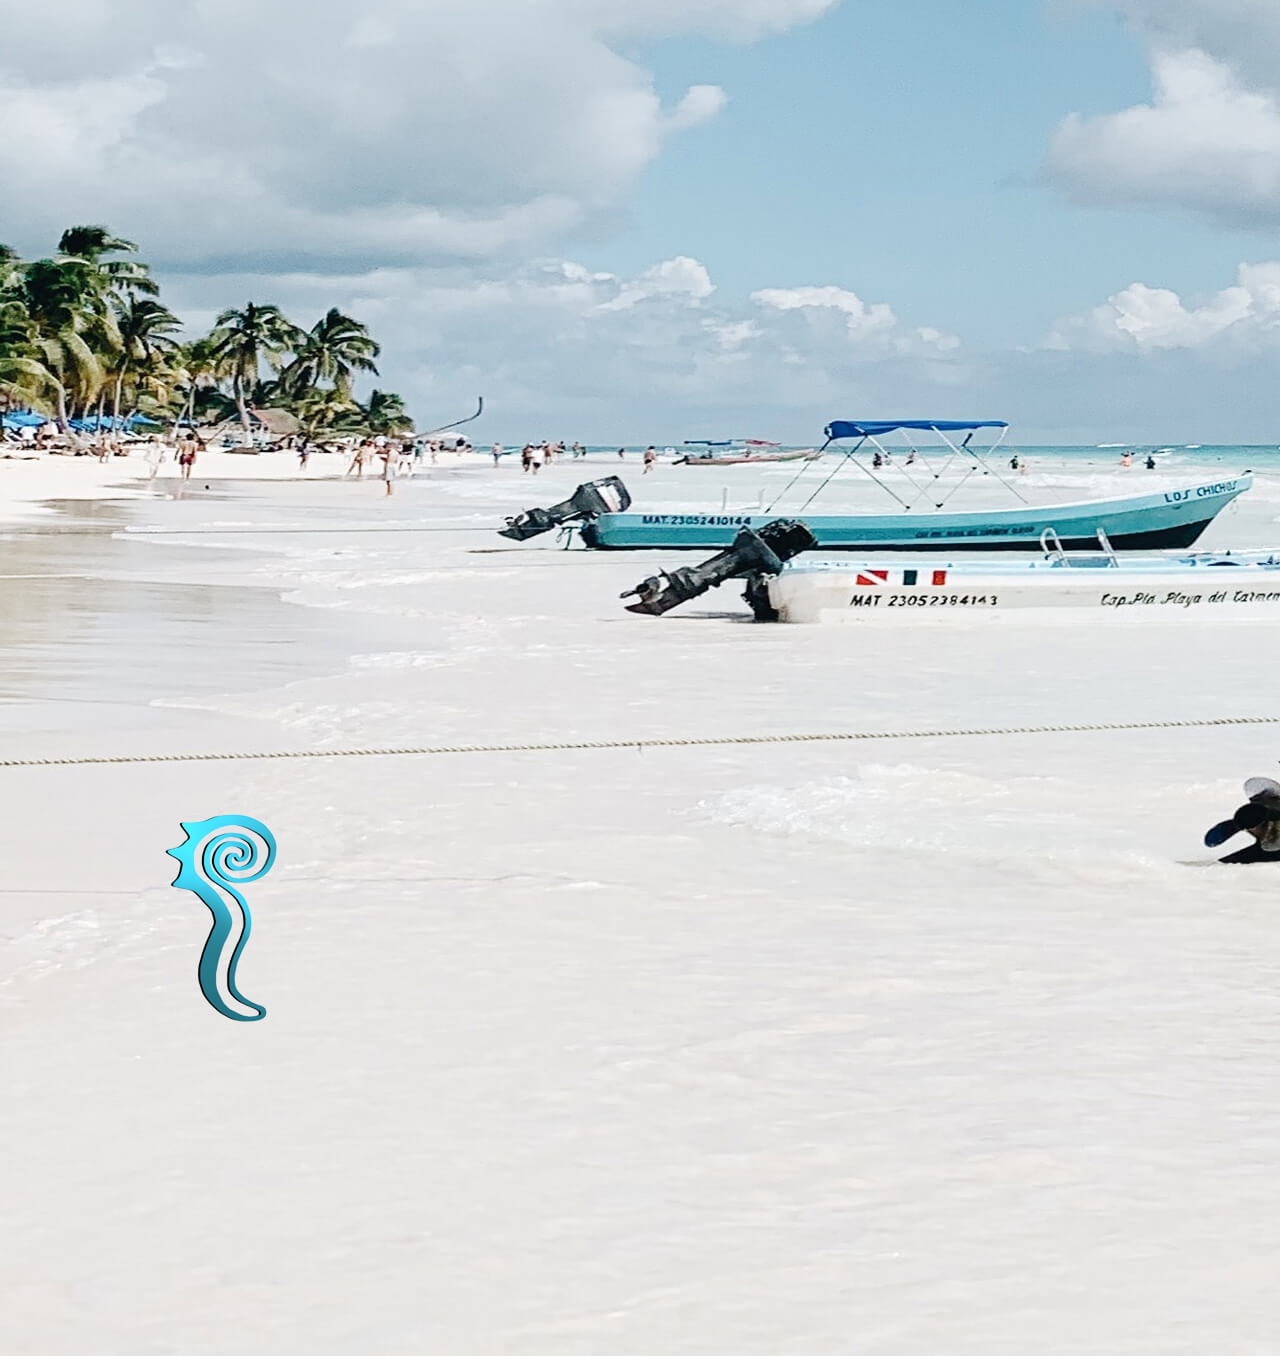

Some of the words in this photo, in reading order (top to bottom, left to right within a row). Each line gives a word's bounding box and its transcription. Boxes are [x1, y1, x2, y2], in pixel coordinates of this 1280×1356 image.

[1164, 489, 1191, 503] LOS
[849, 594, 882, 607] MAT
[1160, 592, 1203, 608] Playa
